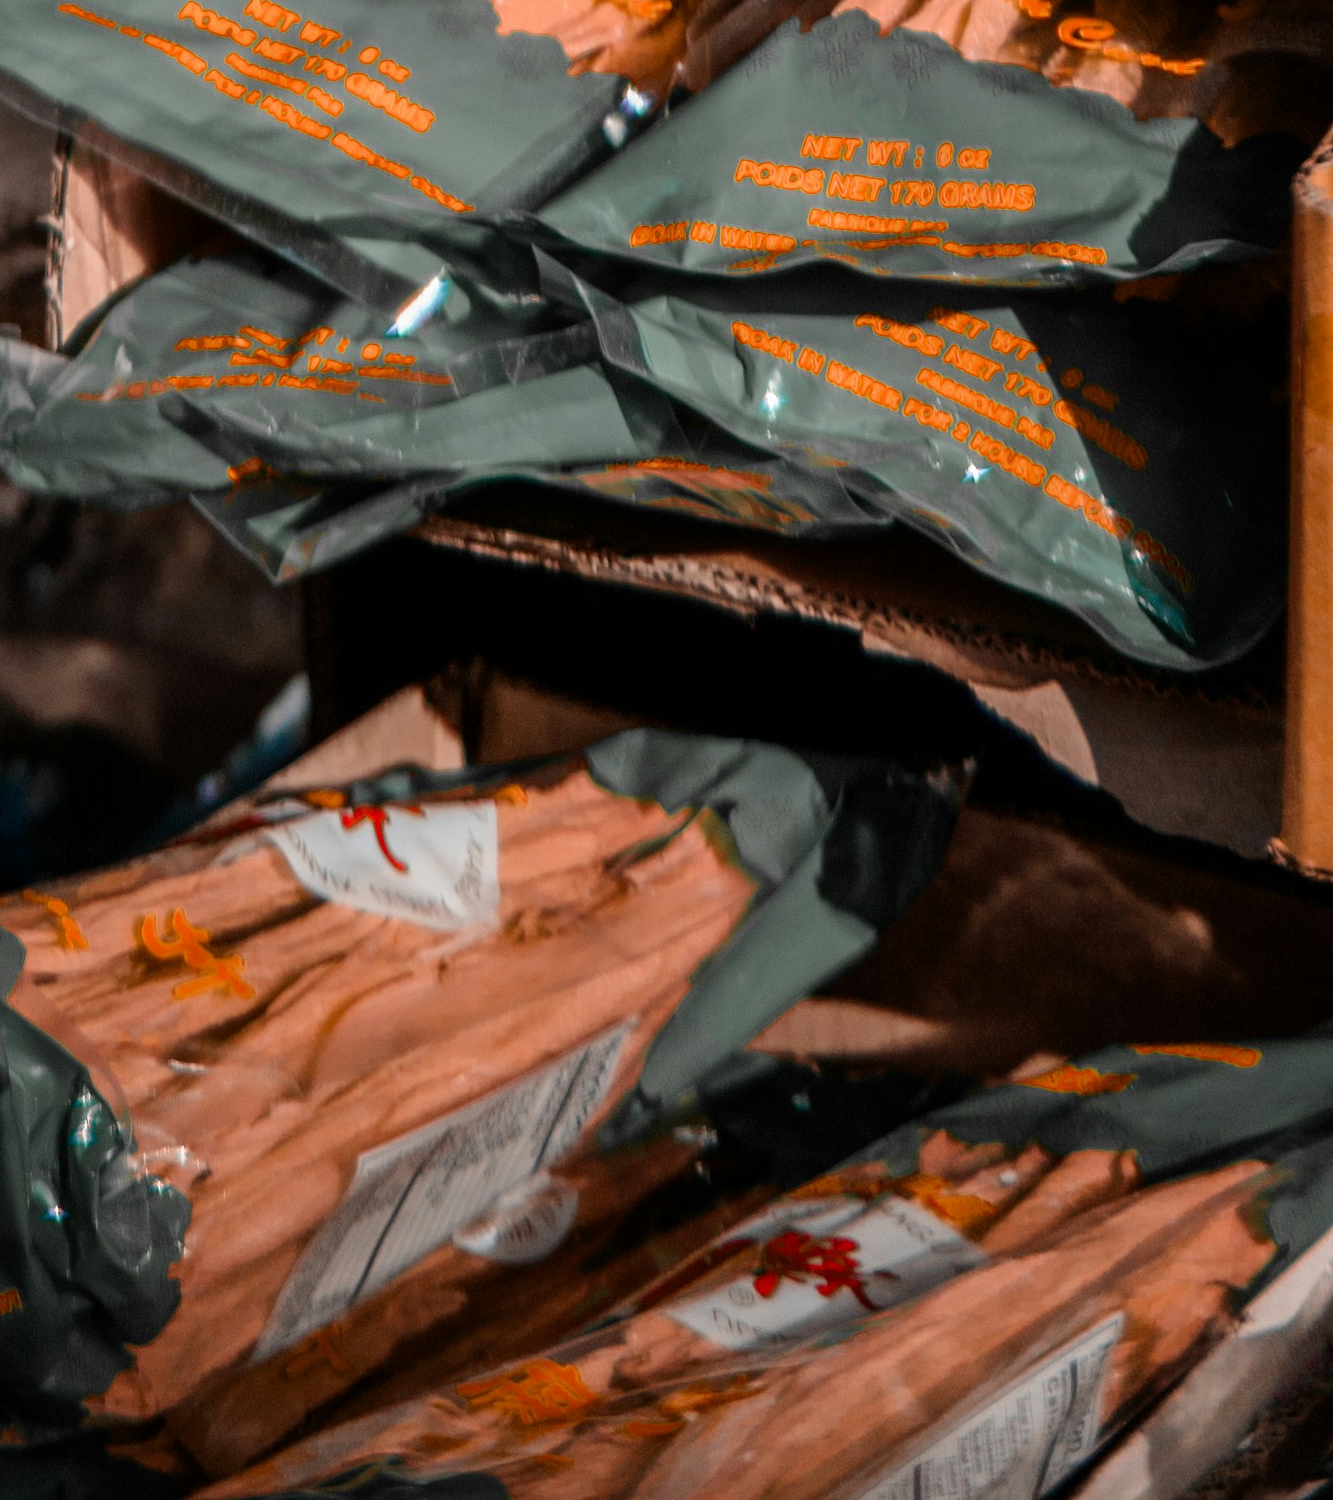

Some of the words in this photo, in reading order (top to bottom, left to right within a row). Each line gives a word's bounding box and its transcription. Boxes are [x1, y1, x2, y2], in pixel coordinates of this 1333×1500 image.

[800, 134, 863, 162] NET
[734, 158, 826, 196] POIDS
[827, 171, 886, 204] NET
[889, 179, 935, 208] 170
[938, 180, 1037, 213] GRAMS
[689, 220, 717, 245] IN
[942, 344, 1005, 382] NET
[1004, 372, 1053, 407] 170
[731, 320, 799, 364] SOAK
[796, 347, 827, 376] IN
[825, 359, 903, 412] WATER
[902, 397, 953, 434] FOR
[969, 430, 1047, 488] HOURS
